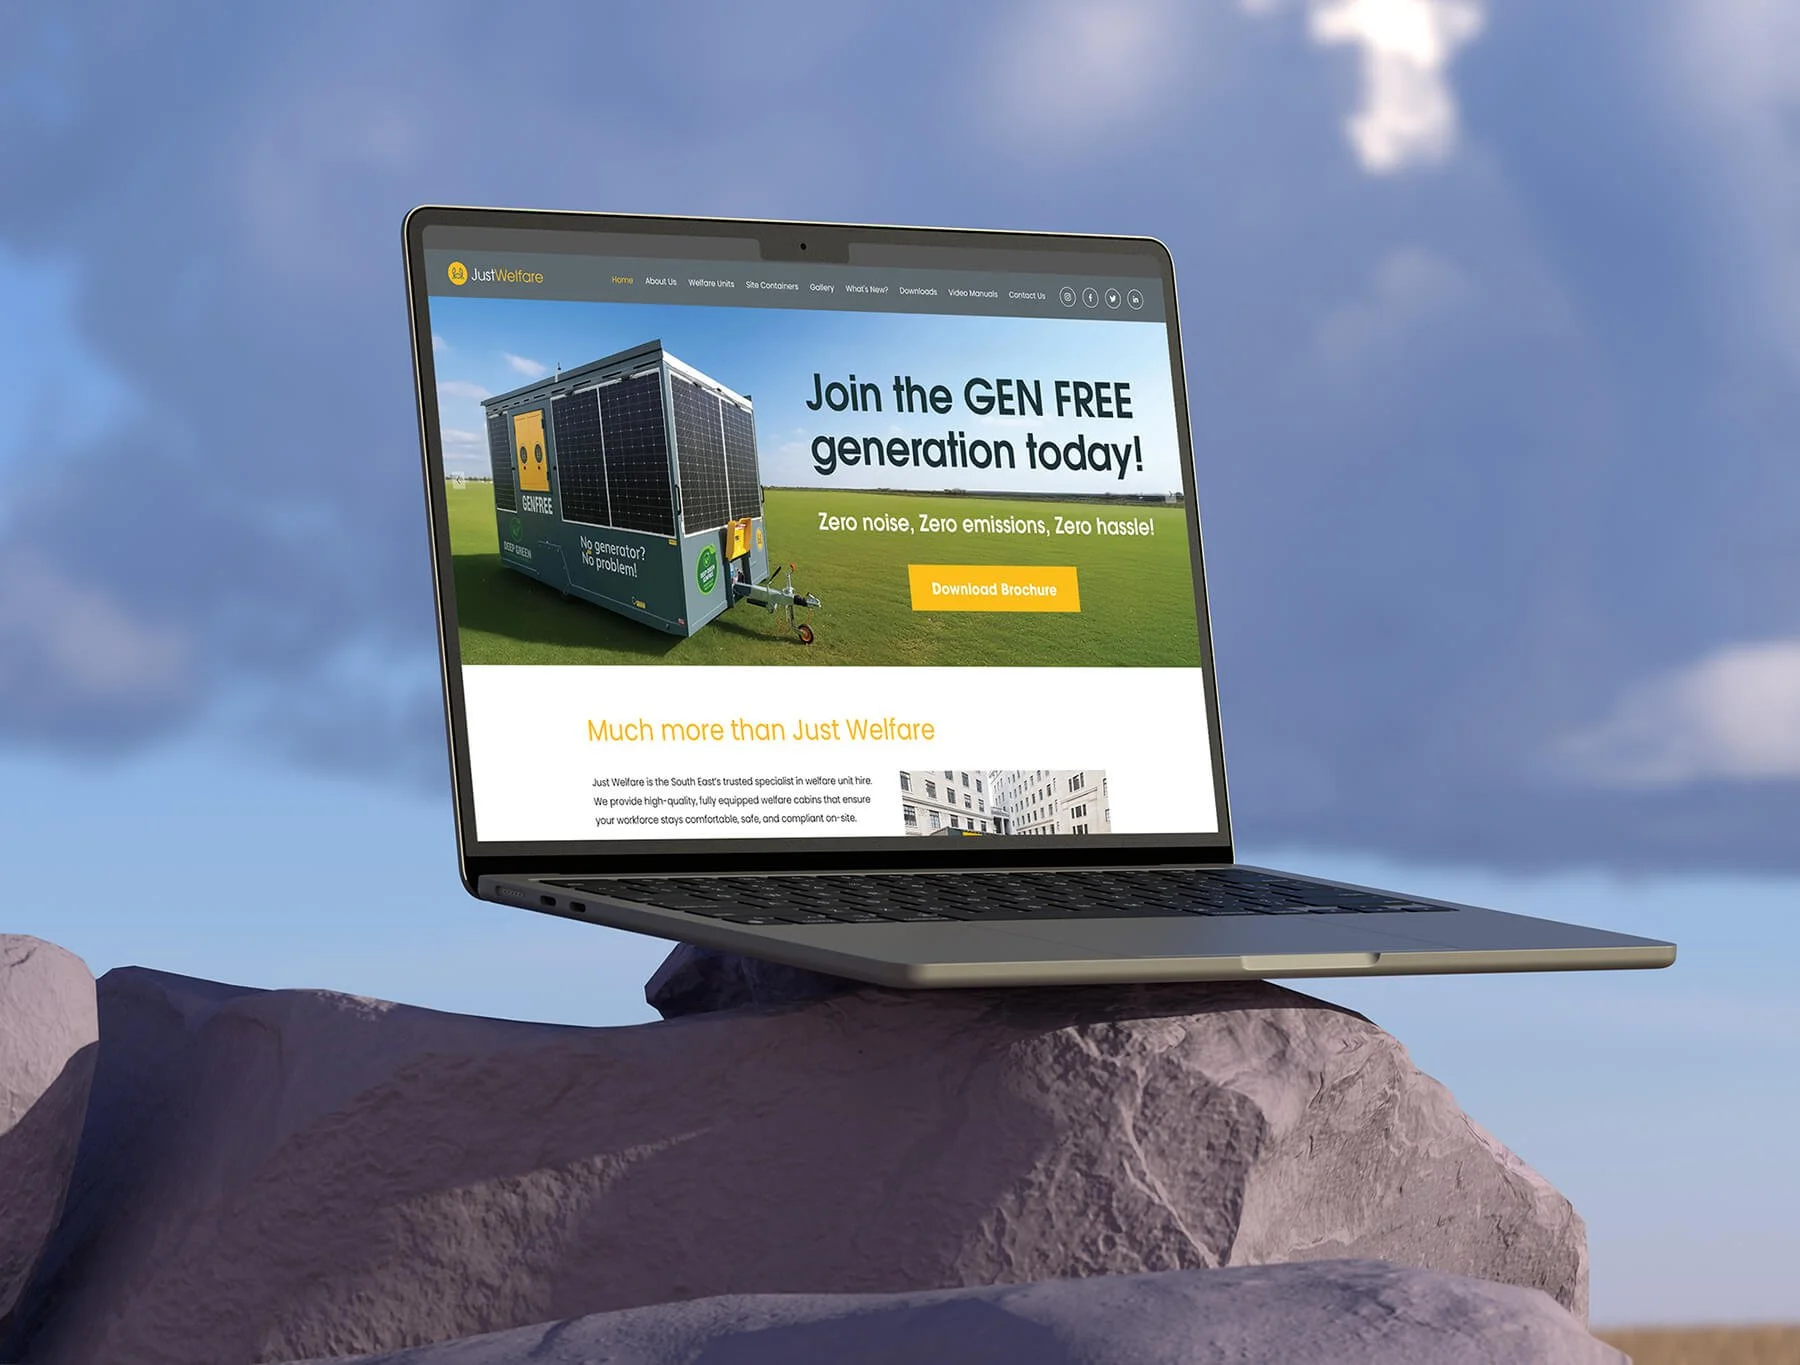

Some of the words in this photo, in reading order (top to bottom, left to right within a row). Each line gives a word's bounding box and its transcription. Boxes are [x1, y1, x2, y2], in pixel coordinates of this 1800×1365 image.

[472, 268, 543, 283] JustWelfare
[612, 276, 633, 284] Home
[645, 277, 666, 286] About
[667, 278, 677, 286] Us
[717, 280, 735, 288] Units
[746, 280, 759, 289] Site
[761, 282, 799, 291] Containers
[810, 283, 834, 293] Gallery
[846, 285, 868, 293] What's
[900, 287, 937, 295] Downloads
[948, 288, 967, 297] Video
[969, 290, 998, 299] Manuals
[1009, 291, 1032, 300] Contact
[1036, 292, 1046, 301] Us
[806, 373, 882, 412] Join
[893, 376, 952, 414] the
[964, 378, 1043, 416] GEN
[1055, 381, 1133, 418] FREE
[812, 431, 1015, 475] generation
[1026, 433, 1142, 480] today!
[522, 496, 553, 514] GENFREE
[819, 512, 857, 530] Zero
[863, 513, 914, 534] noise,
[919, 514, 957, 532] Zero
[963, 515, 1050, 536] emissions,
[1055, 517, 1091, 535] Zero
[1096, 517, 1154, 535] hassle!
[580, 536, 592, 549] No
[595, 542, 645, 561] generator?
[582, 551, 594, 566] No
[596, 557, 638, 577] problem!
[932, 582, 997, 595] Download
[1001, 583, 1056, 596] Brochure
[588, 718, 653, 741] Much
[662, 723, 724, 741] more
[731, 718, 785, 740] than
[793, 720, 840, 740] Just
[846, 717, 934, 740] Welfare
[592, 779, 610, 787] Just
[611, 778, 644, 786] Welfare
[646, 777, 653, 786] is
[655, 778, 669, 786] the
[671, 777, 695, 786] South
[697, 778, 721, 786] East's
[723, 777, 753, 785] trusted
[755, 777, 794, 788] specialist
[805, 776, 836, 785] welfare
[838, 776, 853, 785] unit
[855, 776, 872, 784] hire.
[610, 797, 642, 808] provide
[644, 796, 698, 808] high-quality,
[699, 796, 716, 807] fully
[718, 795, 759, 807] equipped
[761, 795, 791, 804] welfare
[794, 795, 822, 804] cabins
[824, 795, 841, 804] that
[843, 796, 870, 804] ensure
[596, 818, 614, 827] your
[617, 816, 658, 824] workforce
[661, 816, 683, 826] stays
[685, 815, 739, 824] comfortable,
[741, 814, 761, 824] safe,
[763, 814, 779, 823] and
[782, 814, 824, 824] compliant
[826, 813, 857, 822] on-site.
